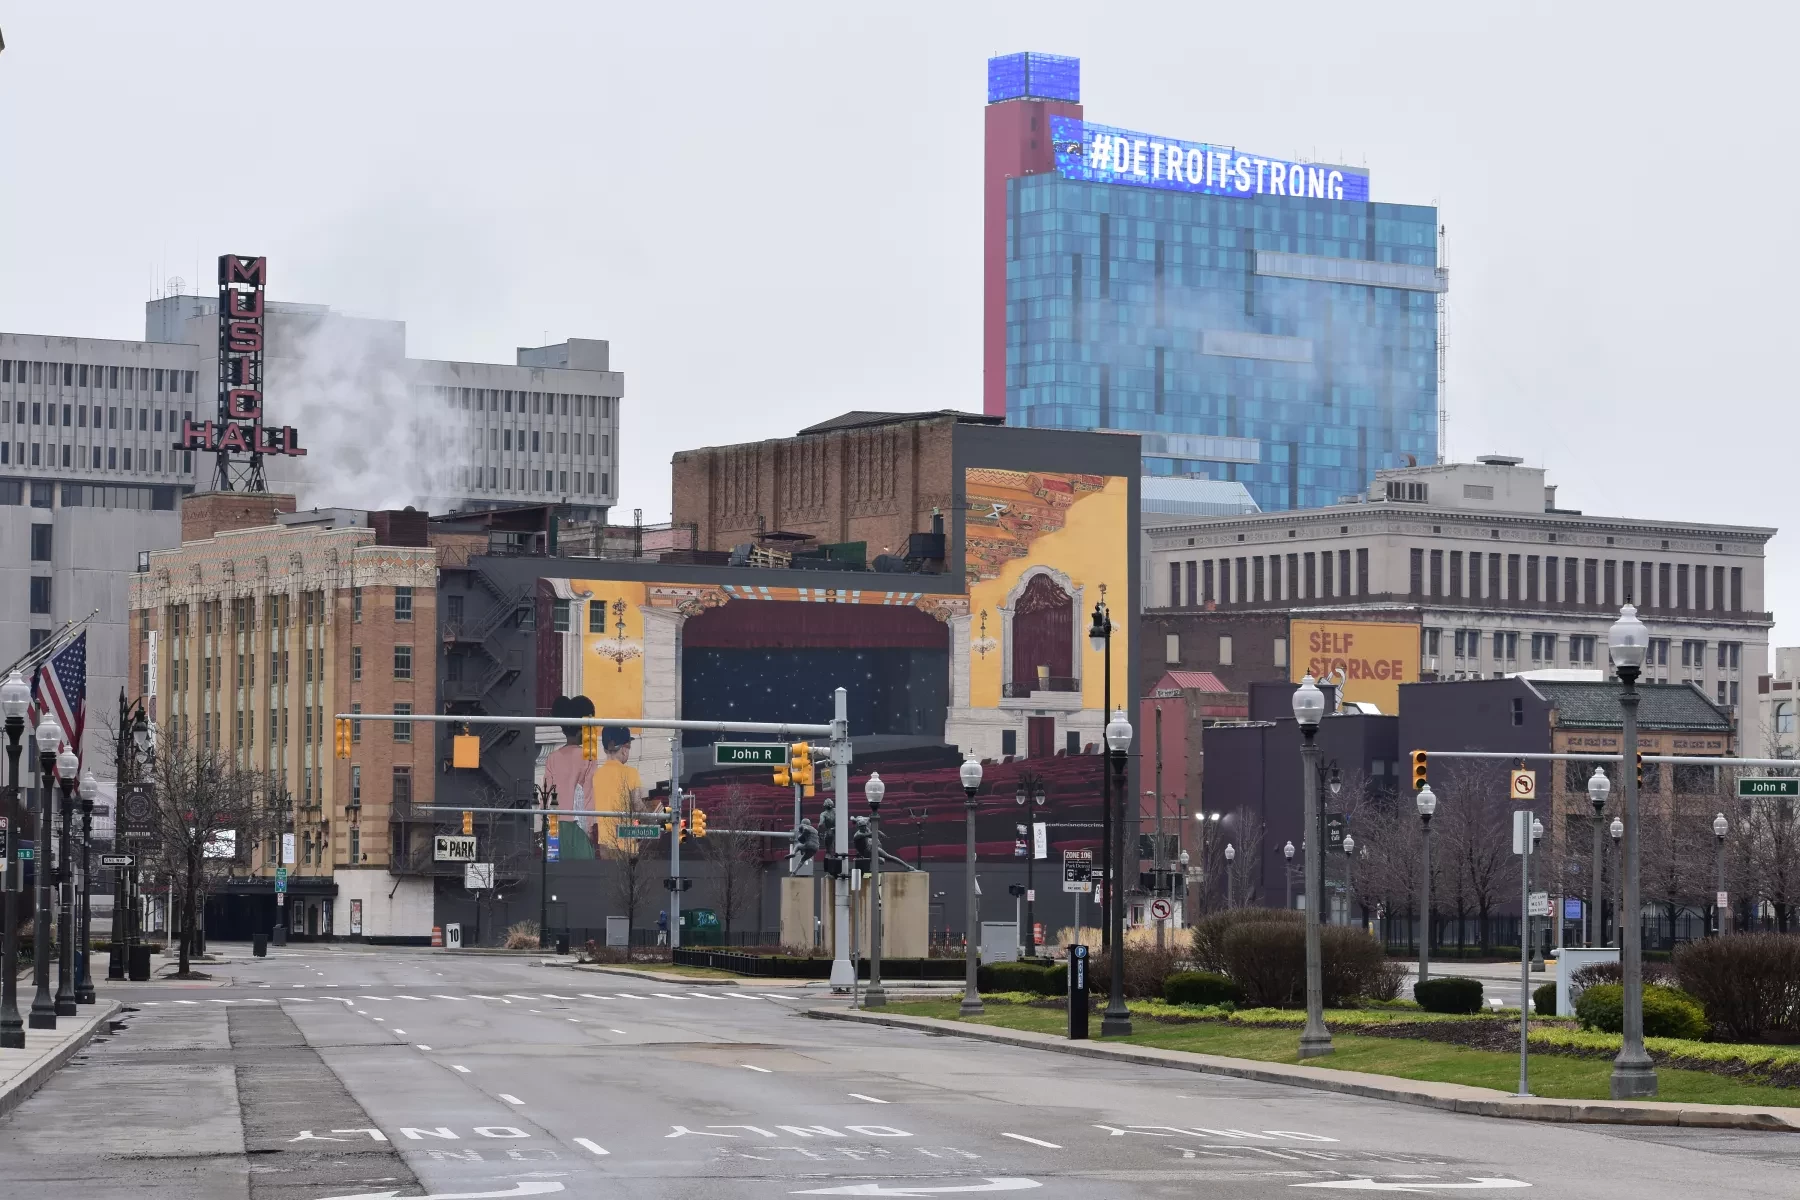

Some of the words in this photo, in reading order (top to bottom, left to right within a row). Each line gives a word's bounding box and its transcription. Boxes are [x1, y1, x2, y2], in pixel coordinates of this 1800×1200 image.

[227, 254, 267, 420] MUSIC
[182, 418, 308, 456] HALL
[1309, 631, 1354, 654] SELF
[1309, 657, 1403, 681] STORAGE
[731, 749, 759, 760] John
[765, 749, 772, 760] R
[1752, 782, 1776, 792] John
[1780, 782, 1787, 792] R
[449, 841, 475, 858] PARK
[287, 1126, 532, 1143] ONLY
[664, 1124, 915, 1138] ONLY
